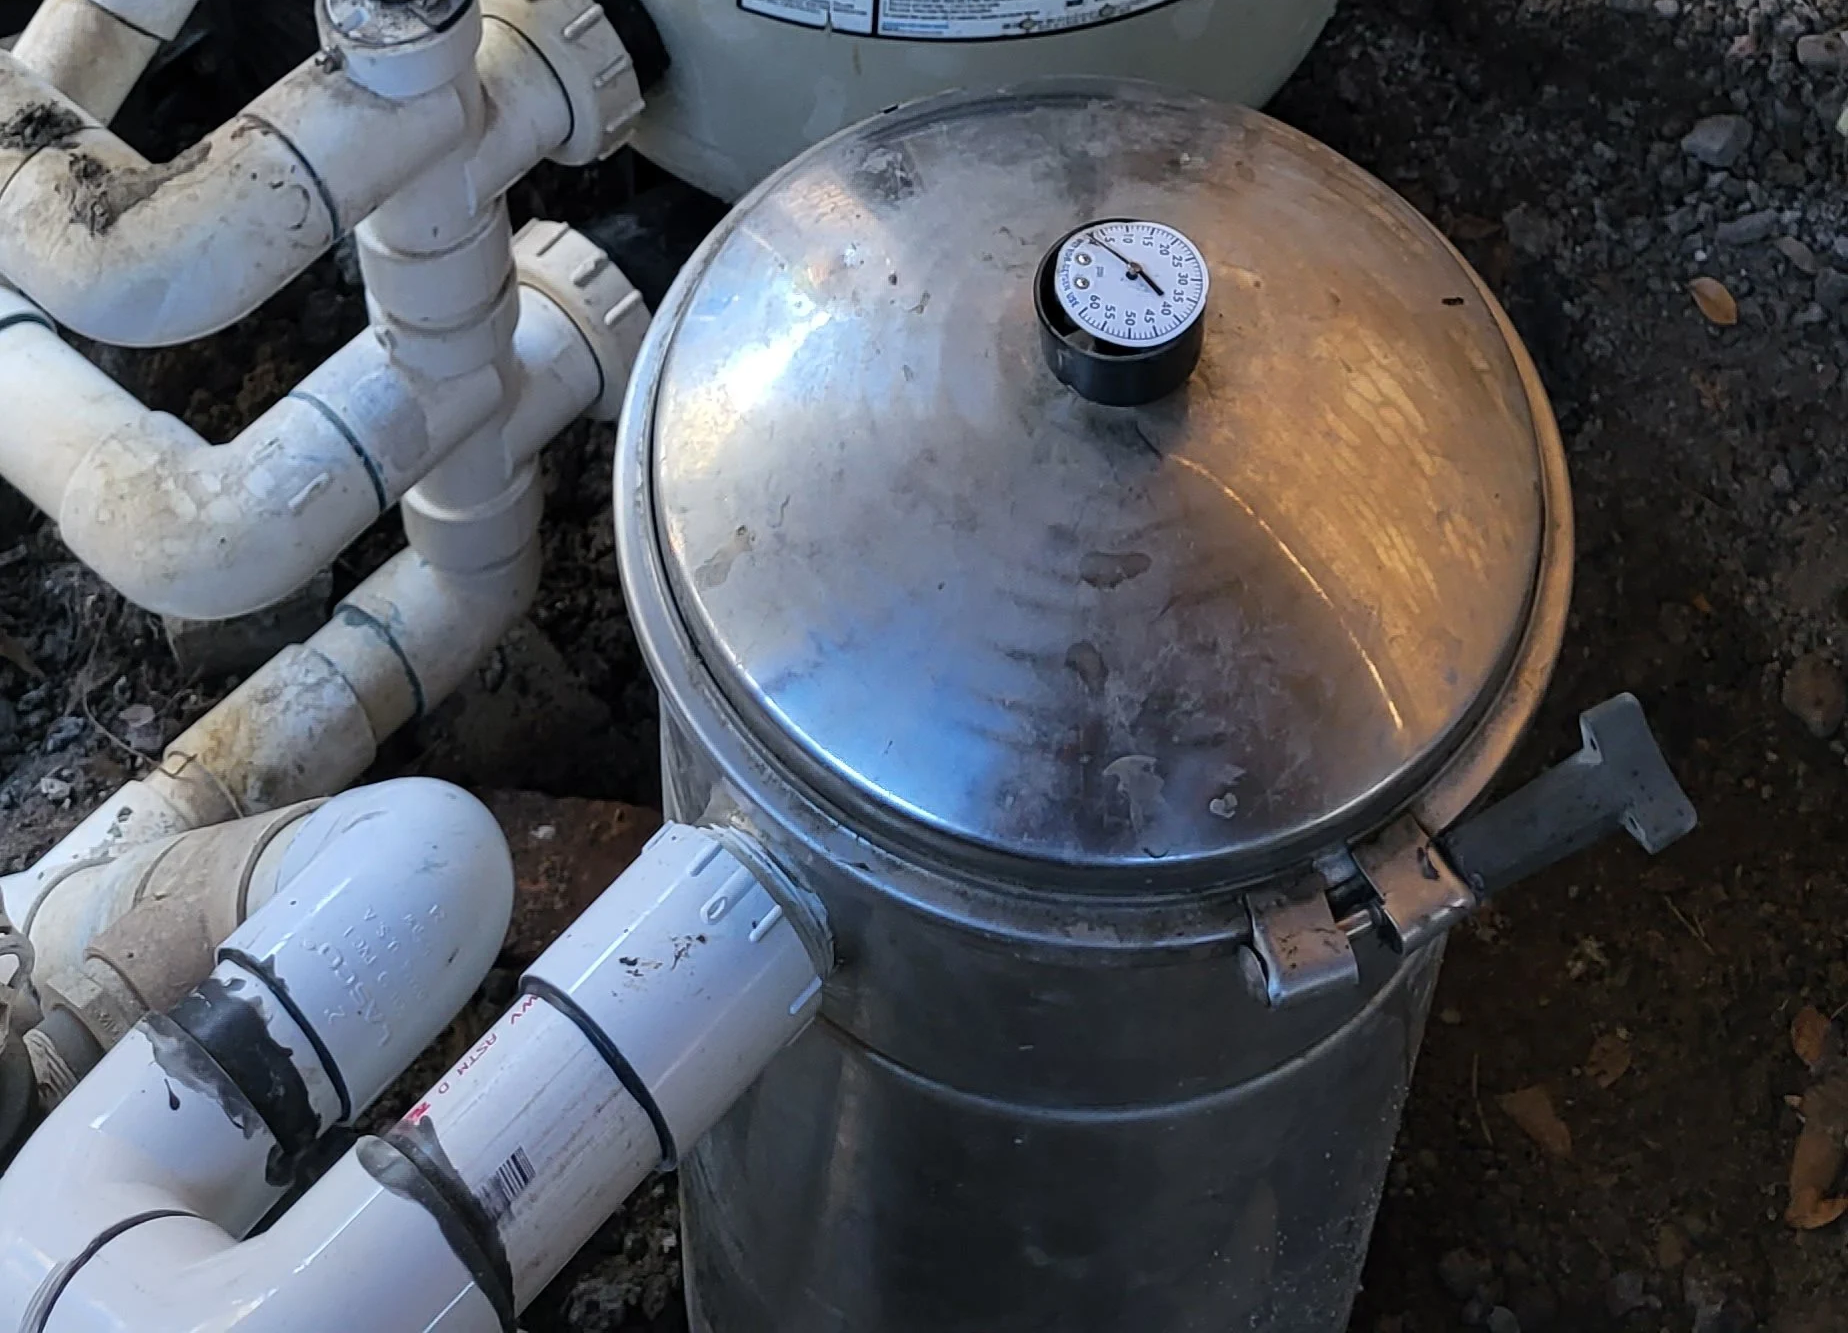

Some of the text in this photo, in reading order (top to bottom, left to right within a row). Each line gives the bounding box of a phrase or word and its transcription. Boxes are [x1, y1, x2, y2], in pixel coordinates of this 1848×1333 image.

[1123, 233, 1133, 244] 10
[1142, 236, 1153, 247] 15
[1159, 243, 1170, 256] 20
[1172, 255, 1183, 268] 25
[1177, 272, 1188, 286] 30
[1089, 294, 1101, 310] 60
[1173, 289, 1184, 303] 35
[1105, 304, 1116, 320] 55
[1160, 301, 1173, 316] 40
[1124, 310, 1136, 326] 50
[1143, 308, 1156, 324] 45
[457, 1033, 498, 1076] ASTM
